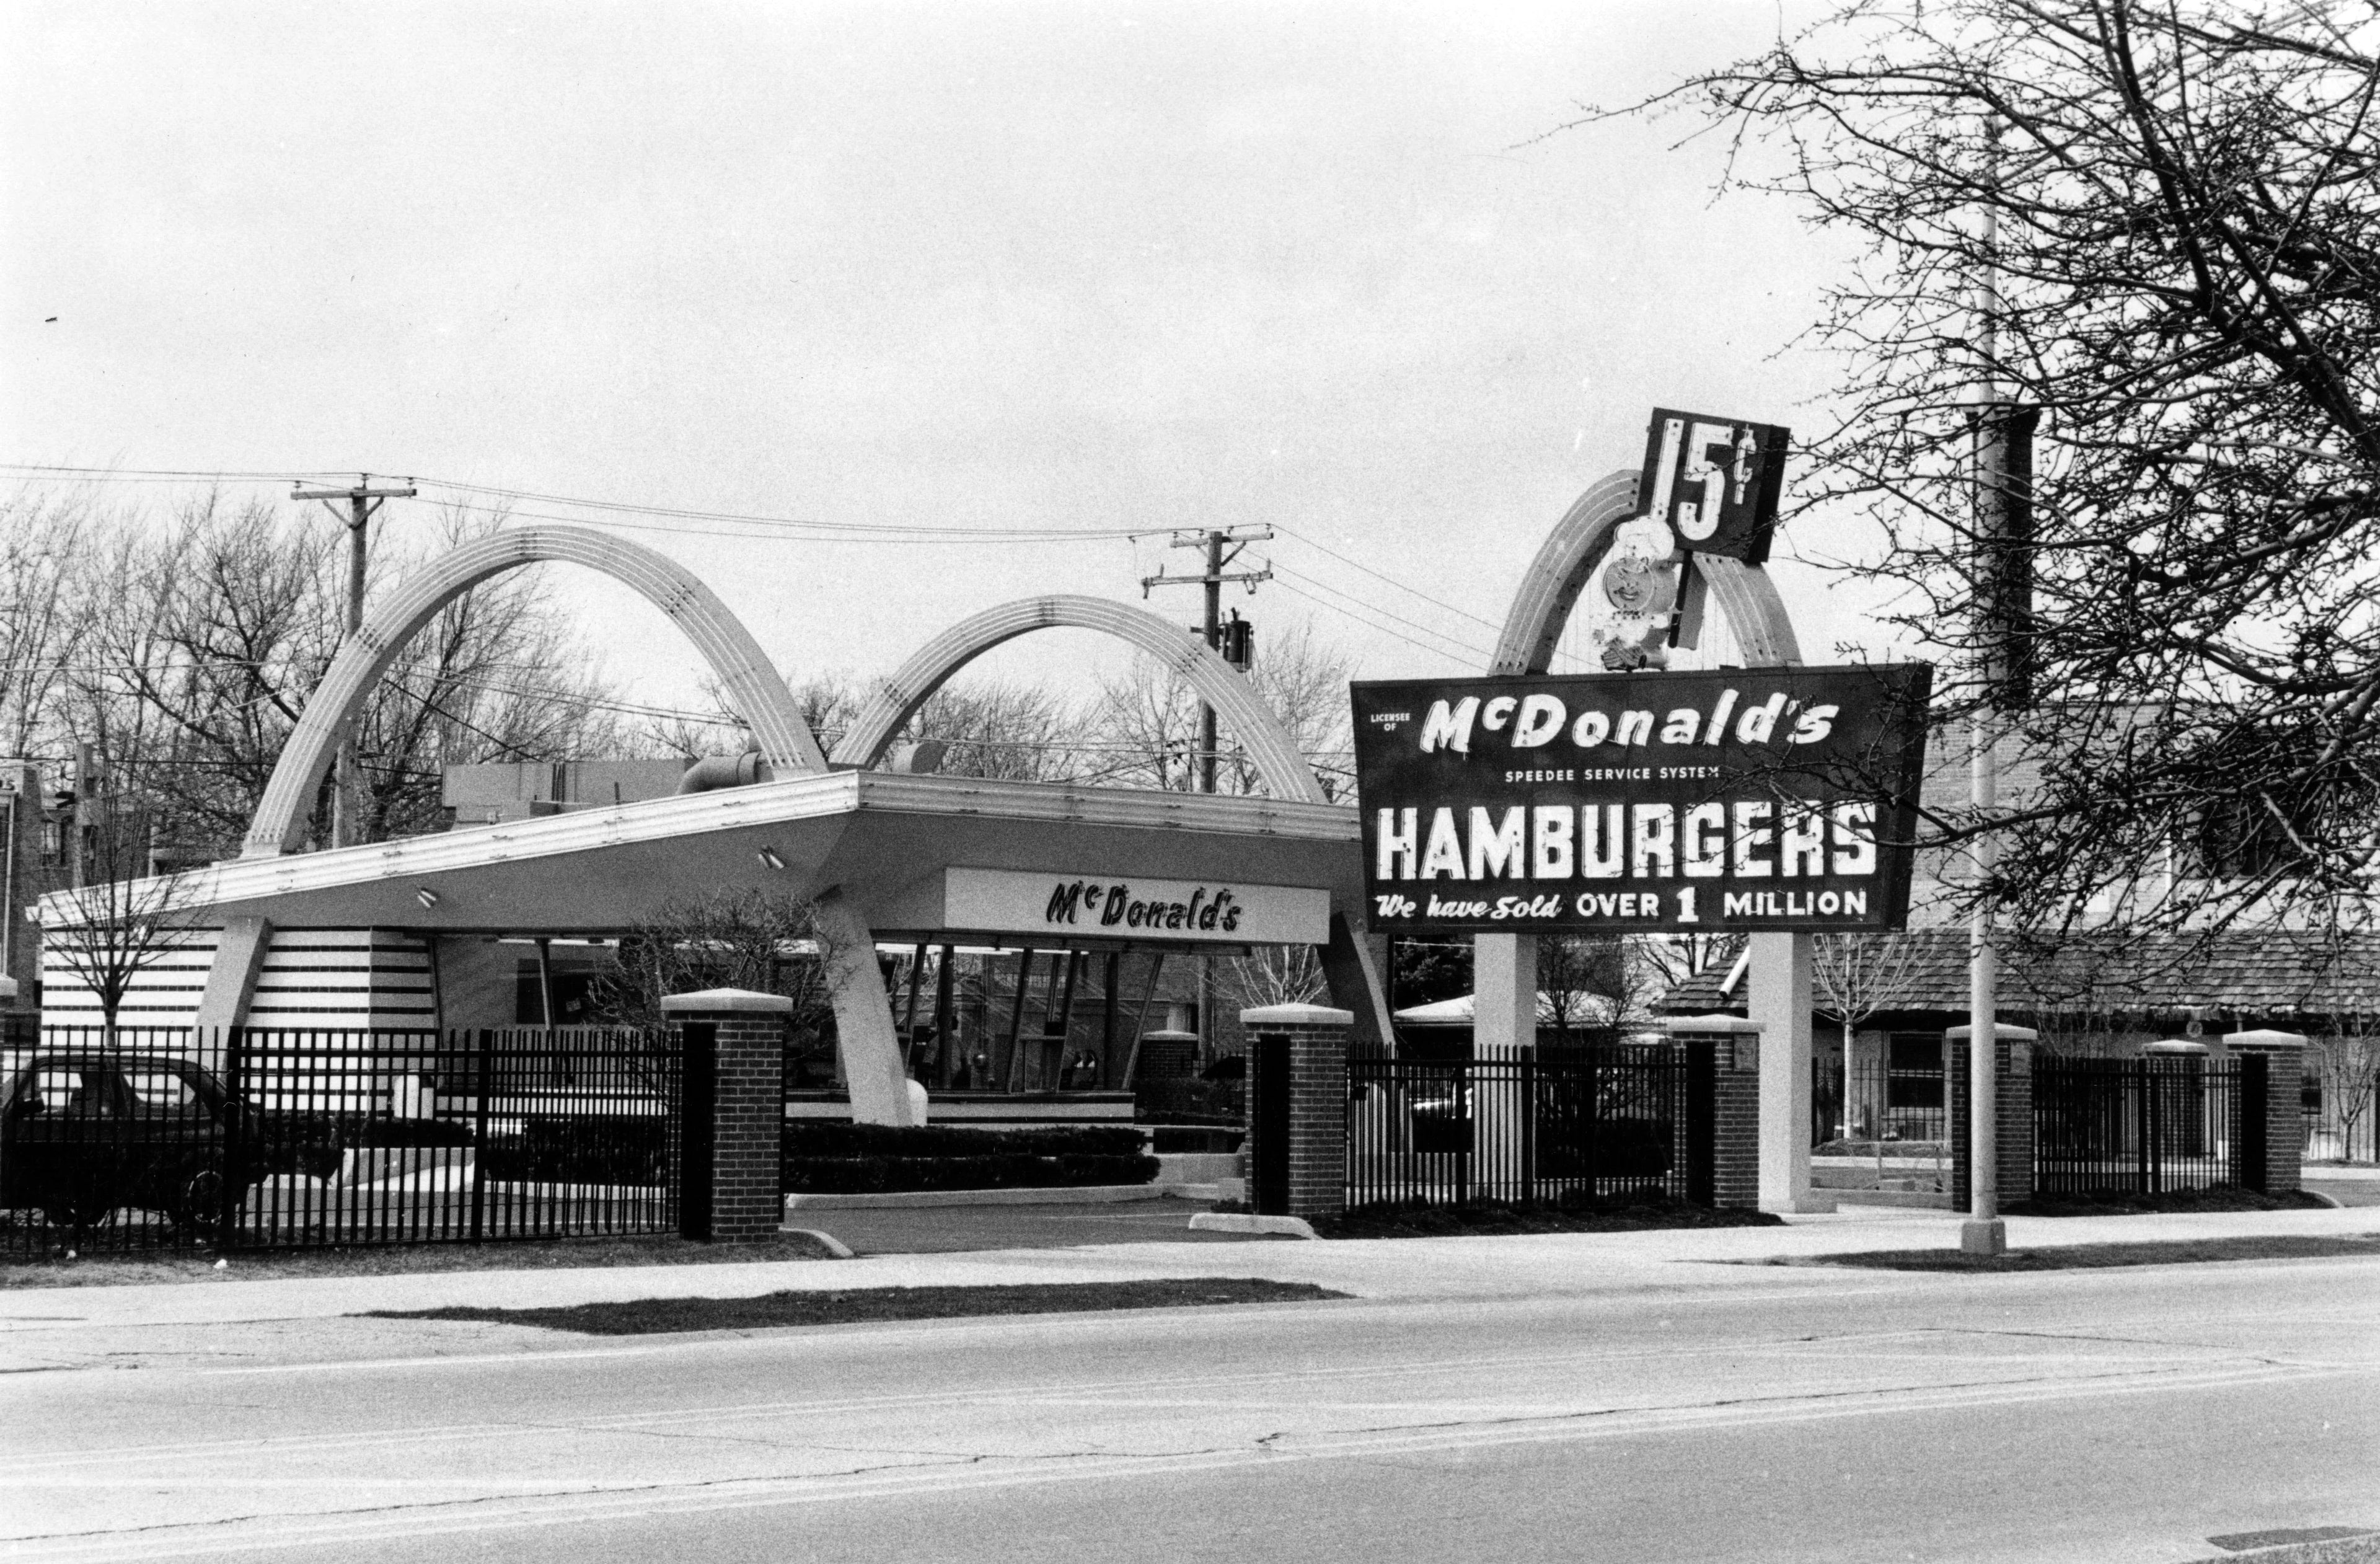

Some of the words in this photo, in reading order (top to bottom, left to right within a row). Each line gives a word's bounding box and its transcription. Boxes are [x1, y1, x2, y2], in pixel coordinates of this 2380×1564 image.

[1371, 713, 1410, 722] LICENSEE
[1384, 723, 1397, 731] OF
[1505, 770, 1574, 782] SPEEDEE
[1584, 768, 1651, 781] SERVICE
[1660, 766, 1719, 779] SYSTEM
[1377, 800, 1876, 881] HAMBURGERS
[1046, 881, 1240, 931] McDonald's
[1375, 895, 1417, 917] We
[1427, 894, 1491, 917] have
[1491, 895, 1562, 919] Sold
[1576, 893, 1659, 917] OVER
[1677, 886, 1699, 922] 1
[1724, 891, 1866, 917] MILLION
